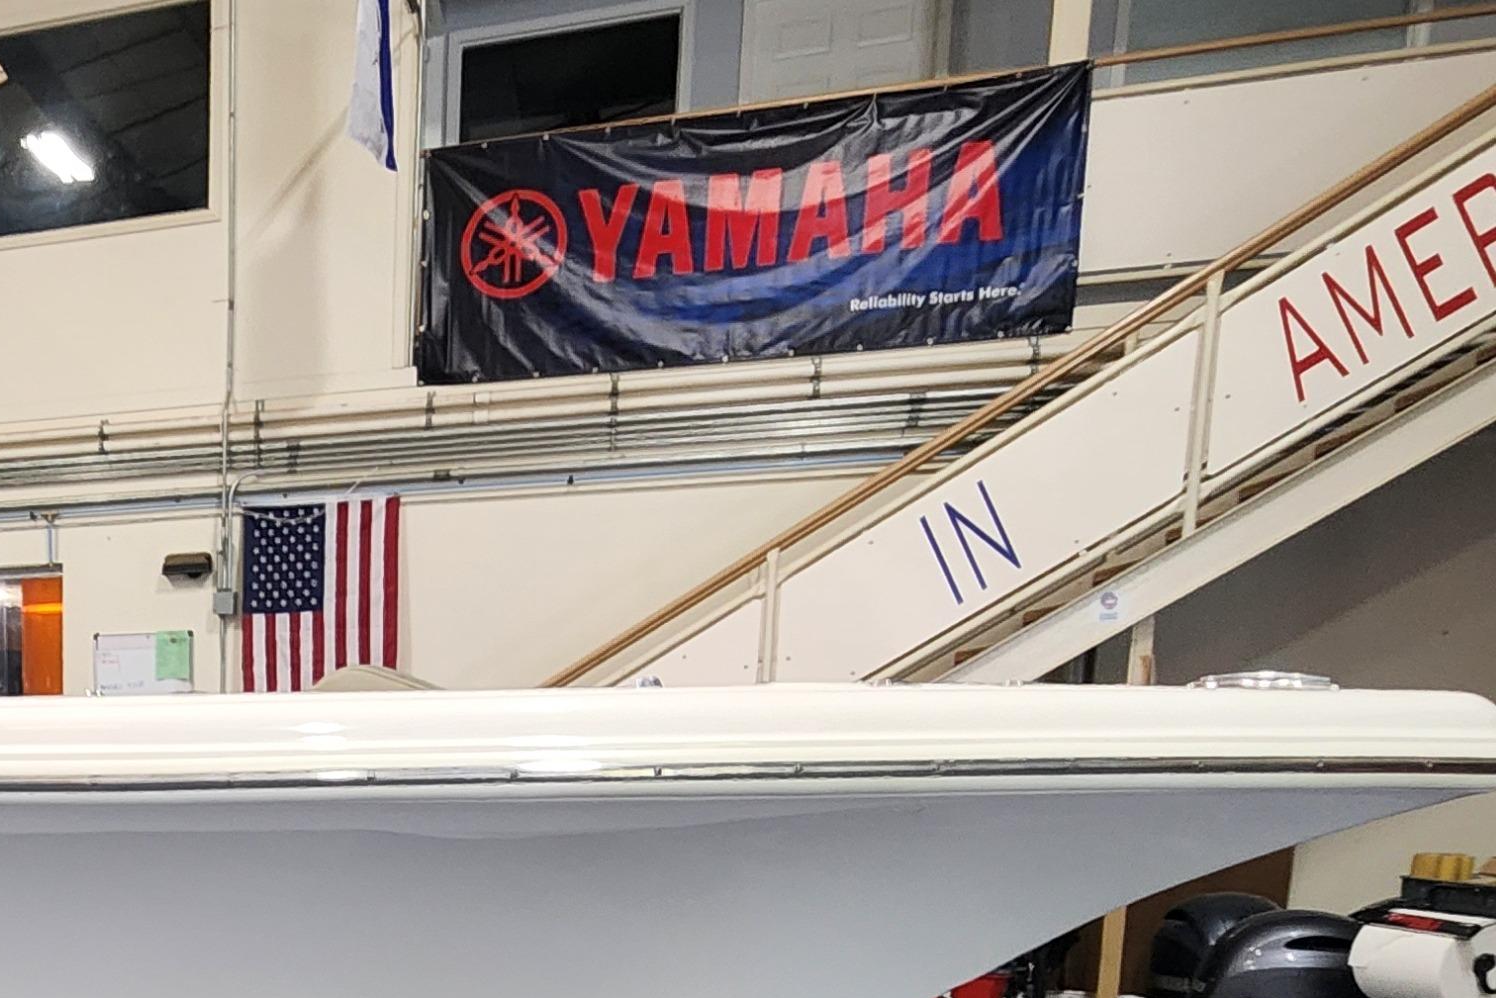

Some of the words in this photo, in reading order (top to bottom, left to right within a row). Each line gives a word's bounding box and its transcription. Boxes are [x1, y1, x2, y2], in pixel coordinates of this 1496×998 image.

[579, 140, 1004, 282] YAMAHA
[850, 293, 926, 312] Reliability
[929, 289, 974, 305] Starts
[919, 480, 1022, 605] IN
